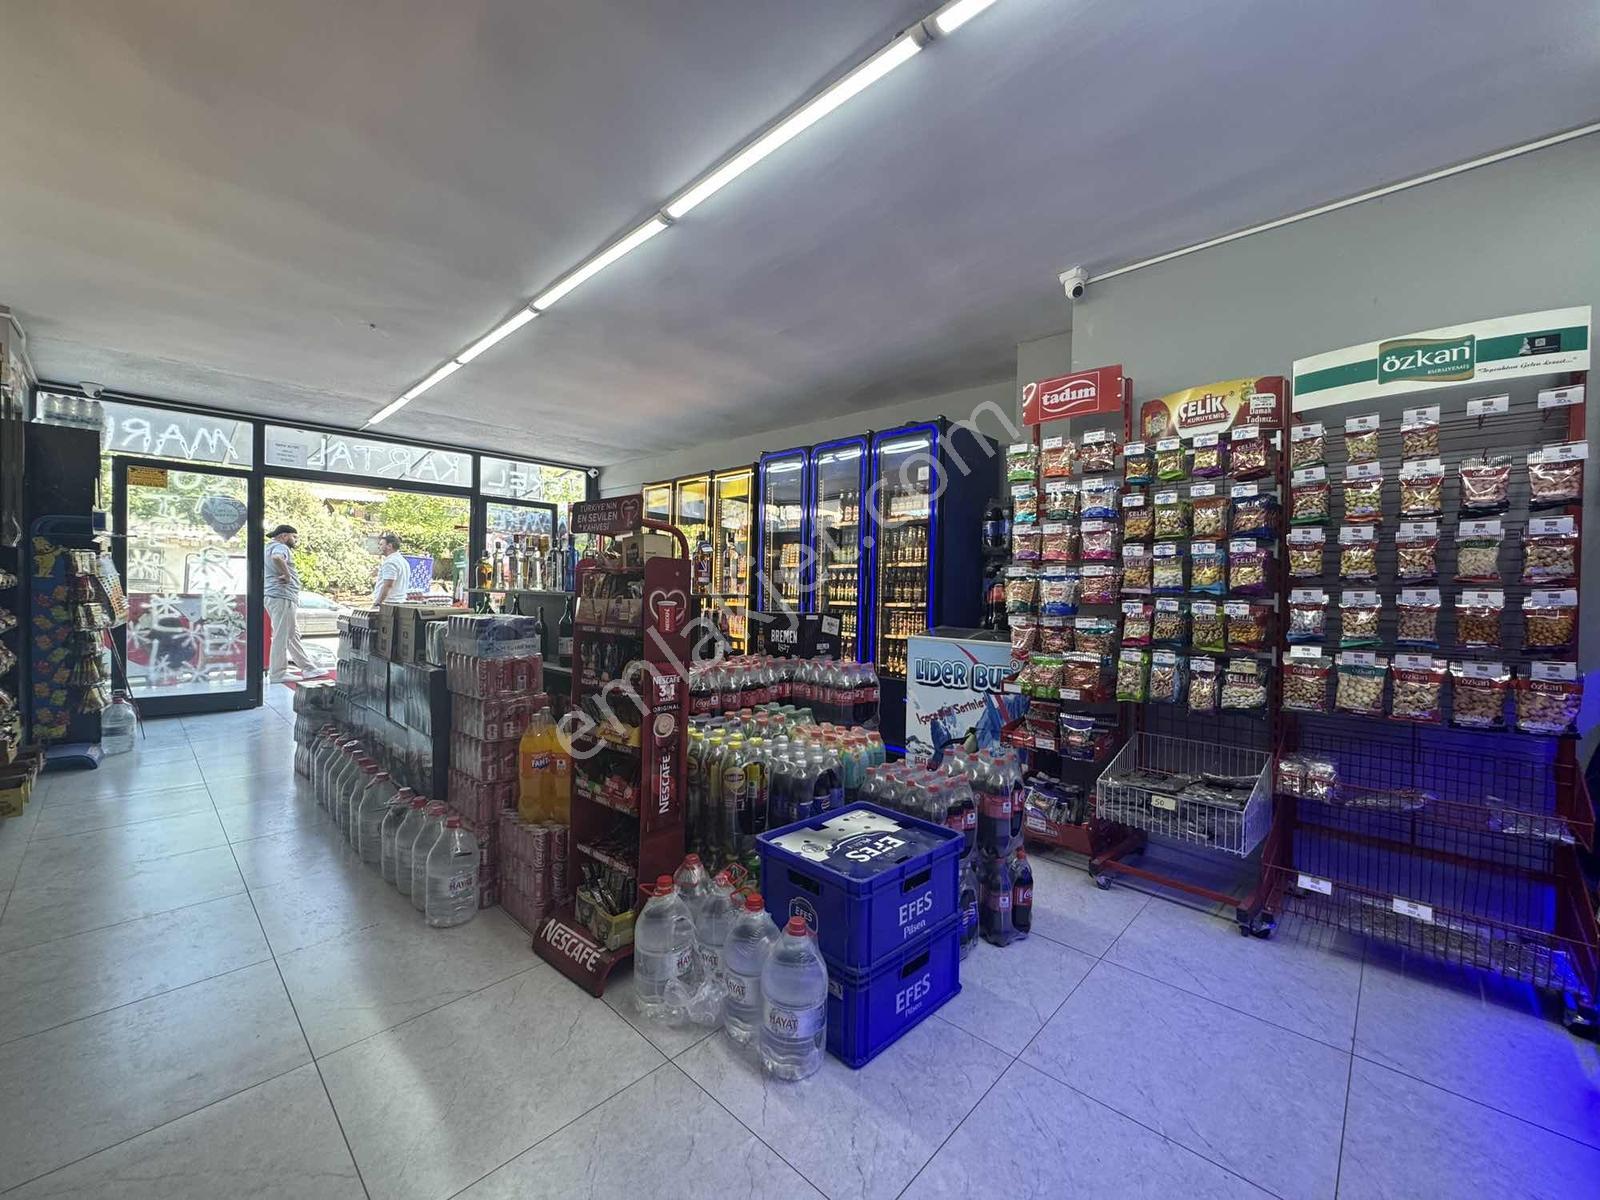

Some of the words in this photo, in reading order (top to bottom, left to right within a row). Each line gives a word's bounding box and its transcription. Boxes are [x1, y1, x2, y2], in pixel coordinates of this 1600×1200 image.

[1382, 345, 1470, 372] özkan
[1041, 386, 1097, 406] tadım
[1179, 393, 1225, 423] ÇELİK
[577, 514, 587, 524] EN
[587, 511, 618, 524] SEVİLEN
[770, 629, 798, 644] BREMEN
[845, 835, 906, 863] EFES
[898, 890, 933, 927] EFES
[903, 918, 927, 939] Pilsen
[895, 973, 931, 1015] EFES
[769, 1013, 798, 1030] HAYAT
